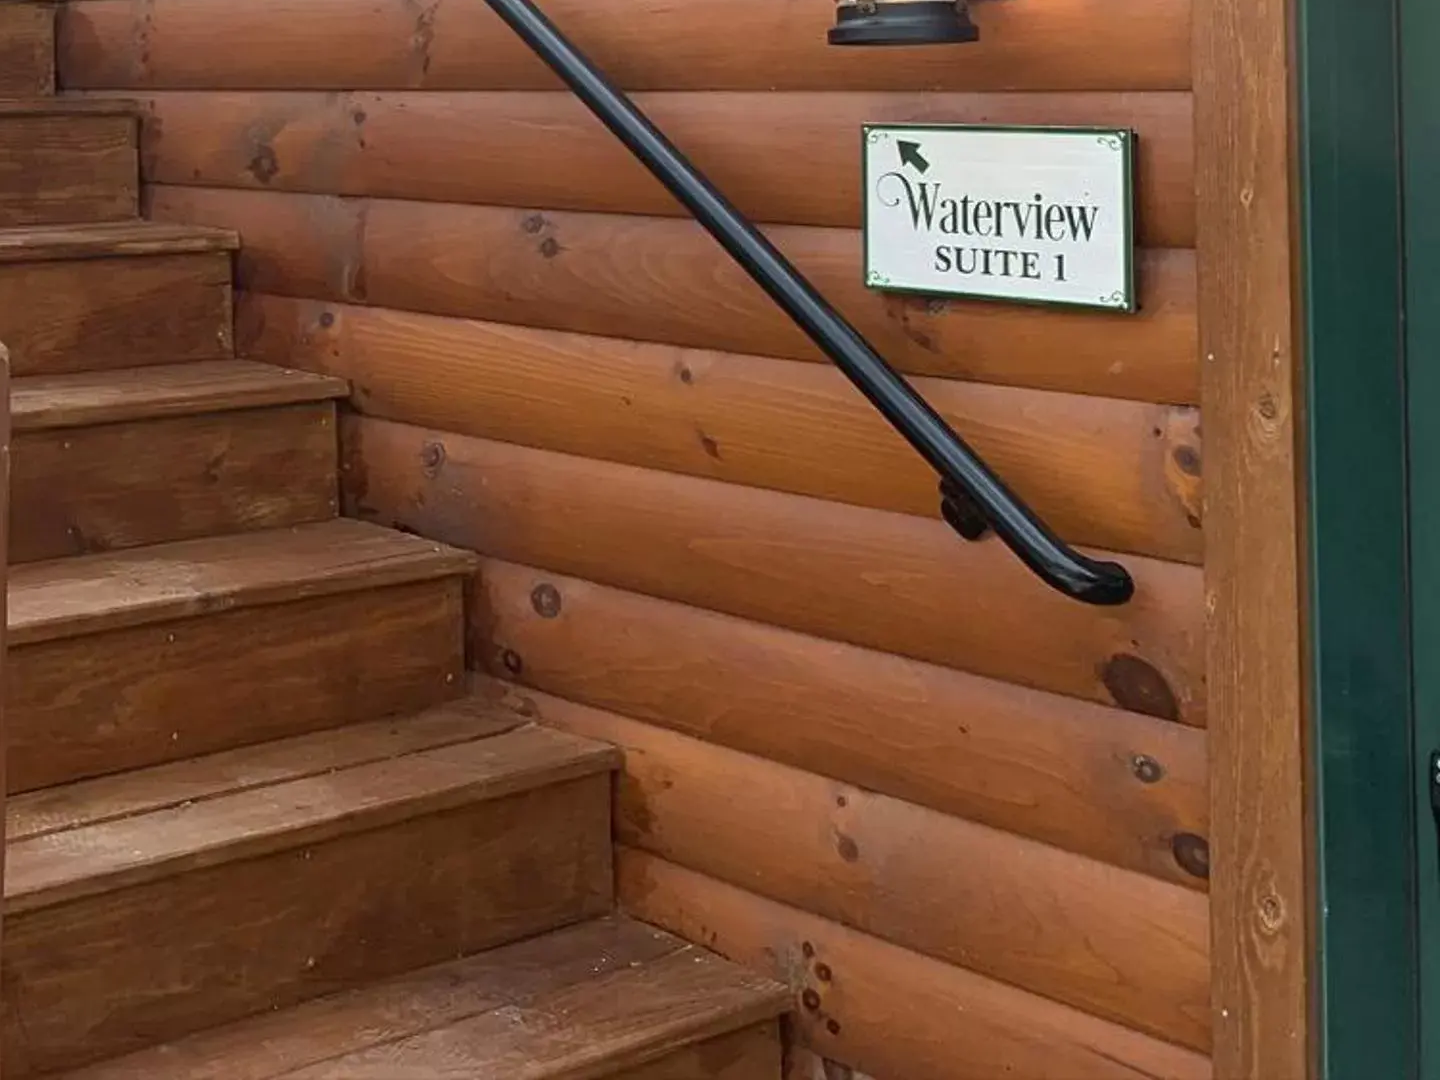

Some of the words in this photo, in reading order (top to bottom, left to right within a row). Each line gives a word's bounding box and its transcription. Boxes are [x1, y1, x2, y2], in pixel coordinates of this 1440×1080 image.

[876, 172, 1098, 242] Waterview
[935, 245, 1041, 279] SUITE
[1054, 254, 1067, 281] 1
